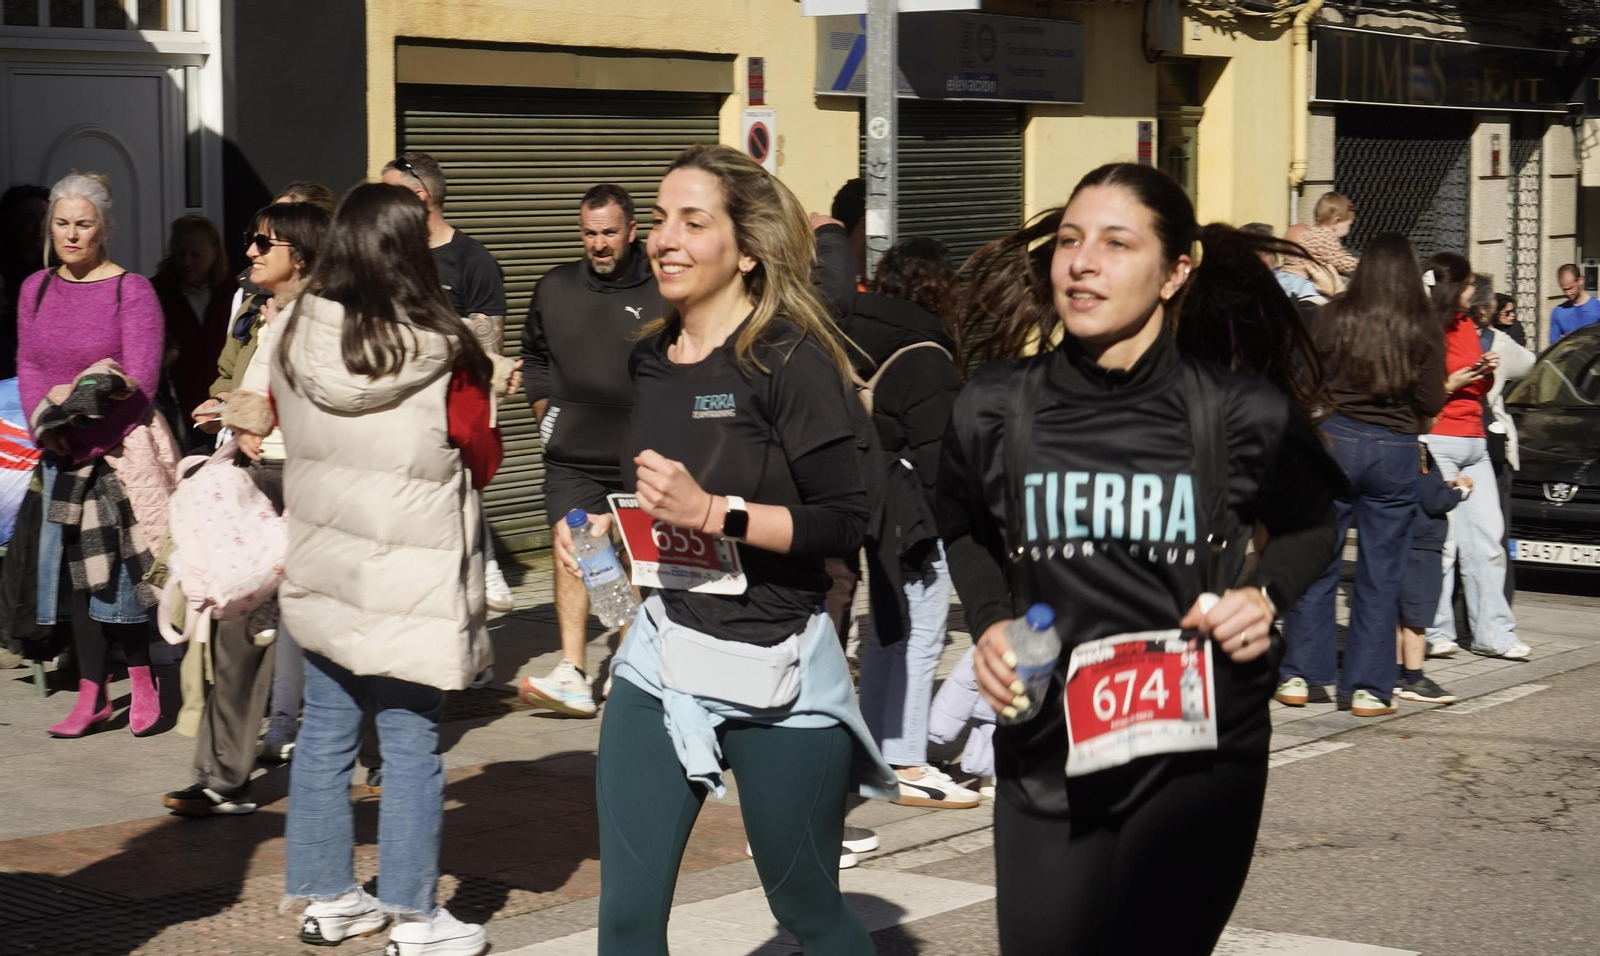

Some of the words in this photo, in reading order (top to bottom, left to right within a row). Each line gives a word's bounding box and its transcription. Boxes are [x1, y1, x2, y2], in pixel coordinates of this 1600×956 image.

[693, 393, 737, 410] TIERRA
[1023, 471, 1197, 545] TIERRA
[651, 521, 706, 556] 655
[1092, 667, 1170, 722] 674
